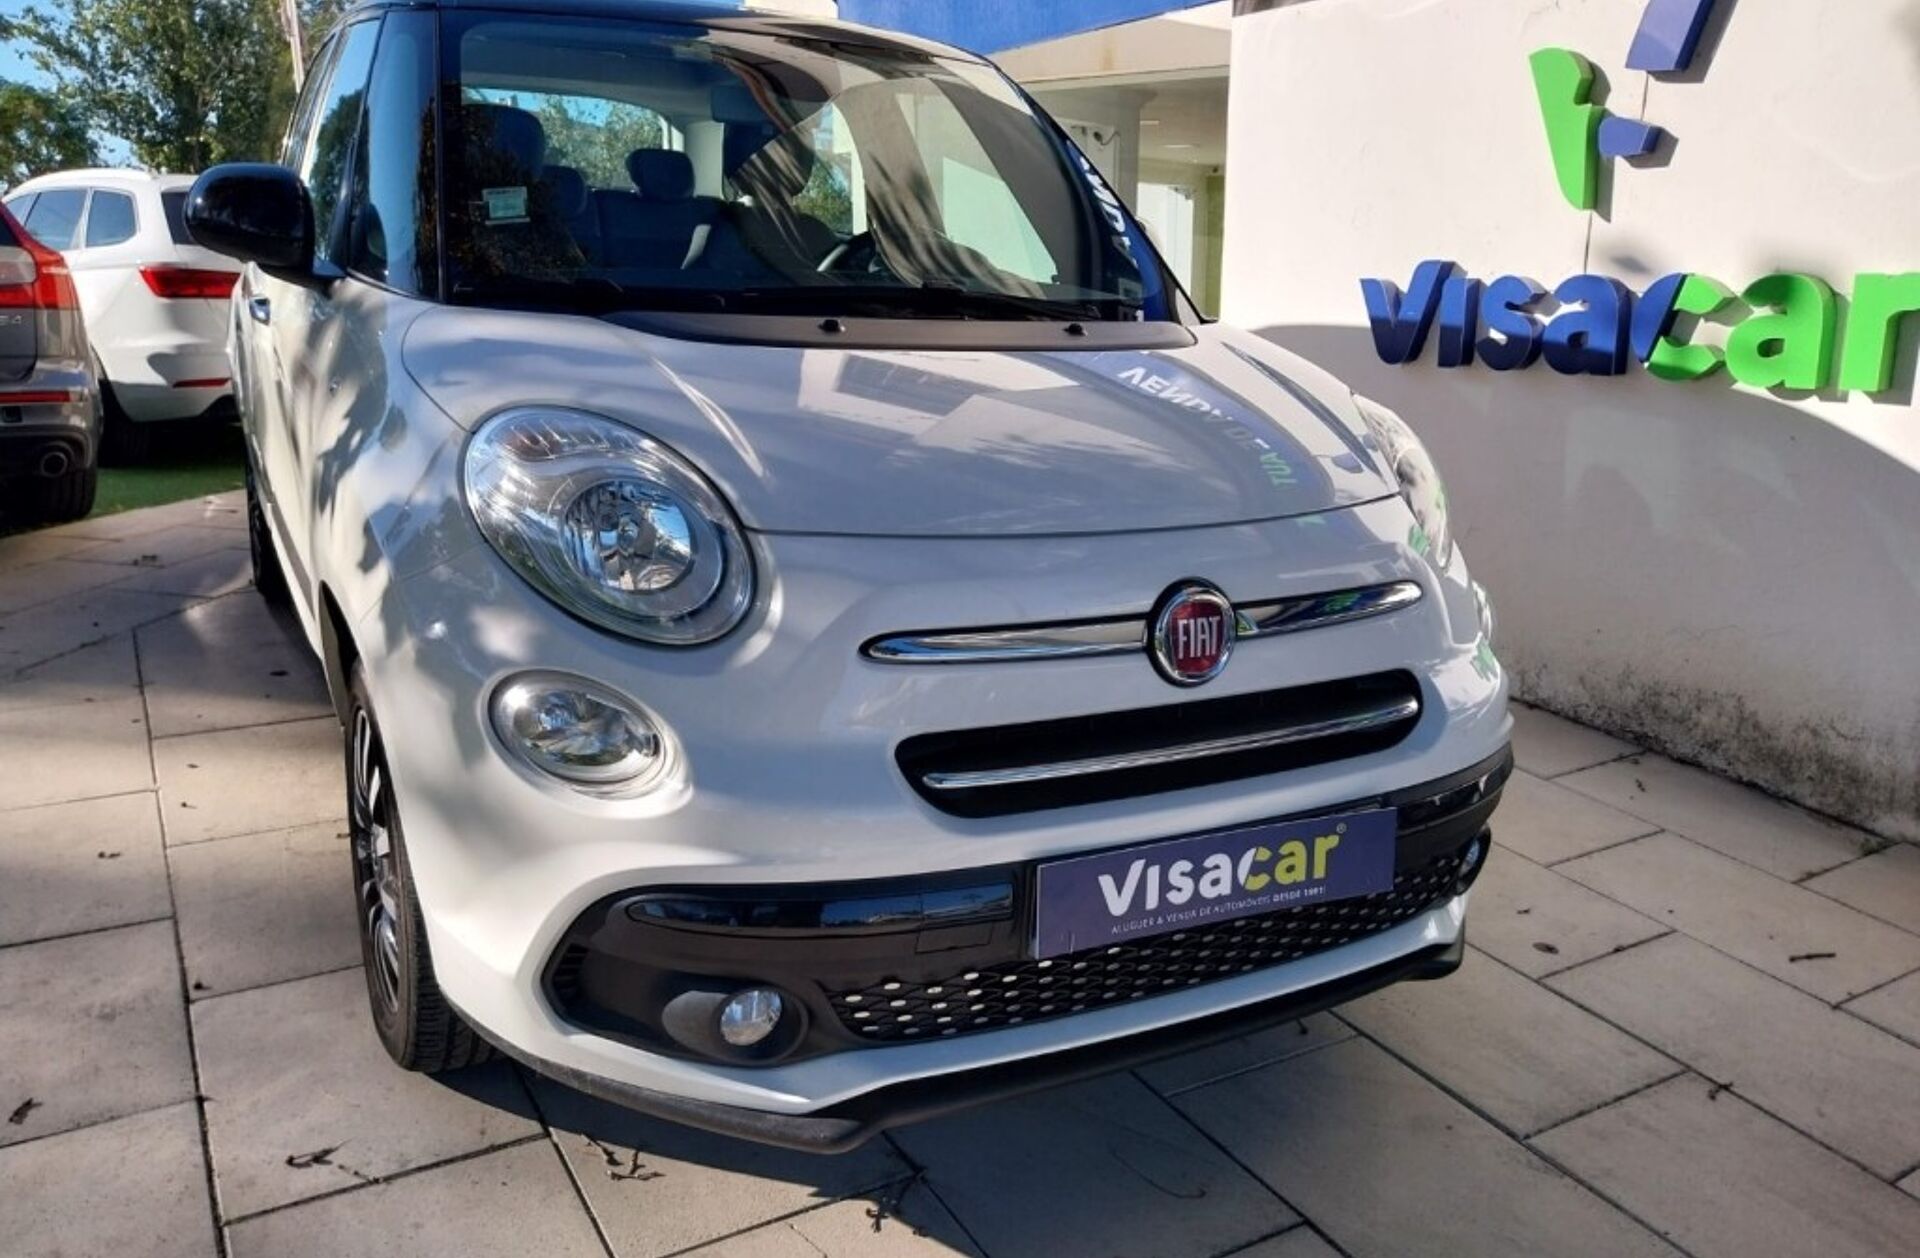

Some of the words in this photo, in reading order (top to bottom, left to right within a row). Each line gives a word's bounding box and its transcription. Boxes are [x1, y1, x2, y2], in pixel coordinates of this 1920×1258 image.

[1177, 616, 1221, 660] FIAT
[1166, 909, 1197, 922] VENDA
[1200, 905, 1211, 917] DE
[1272, 889, 1301, 902] DESDE
